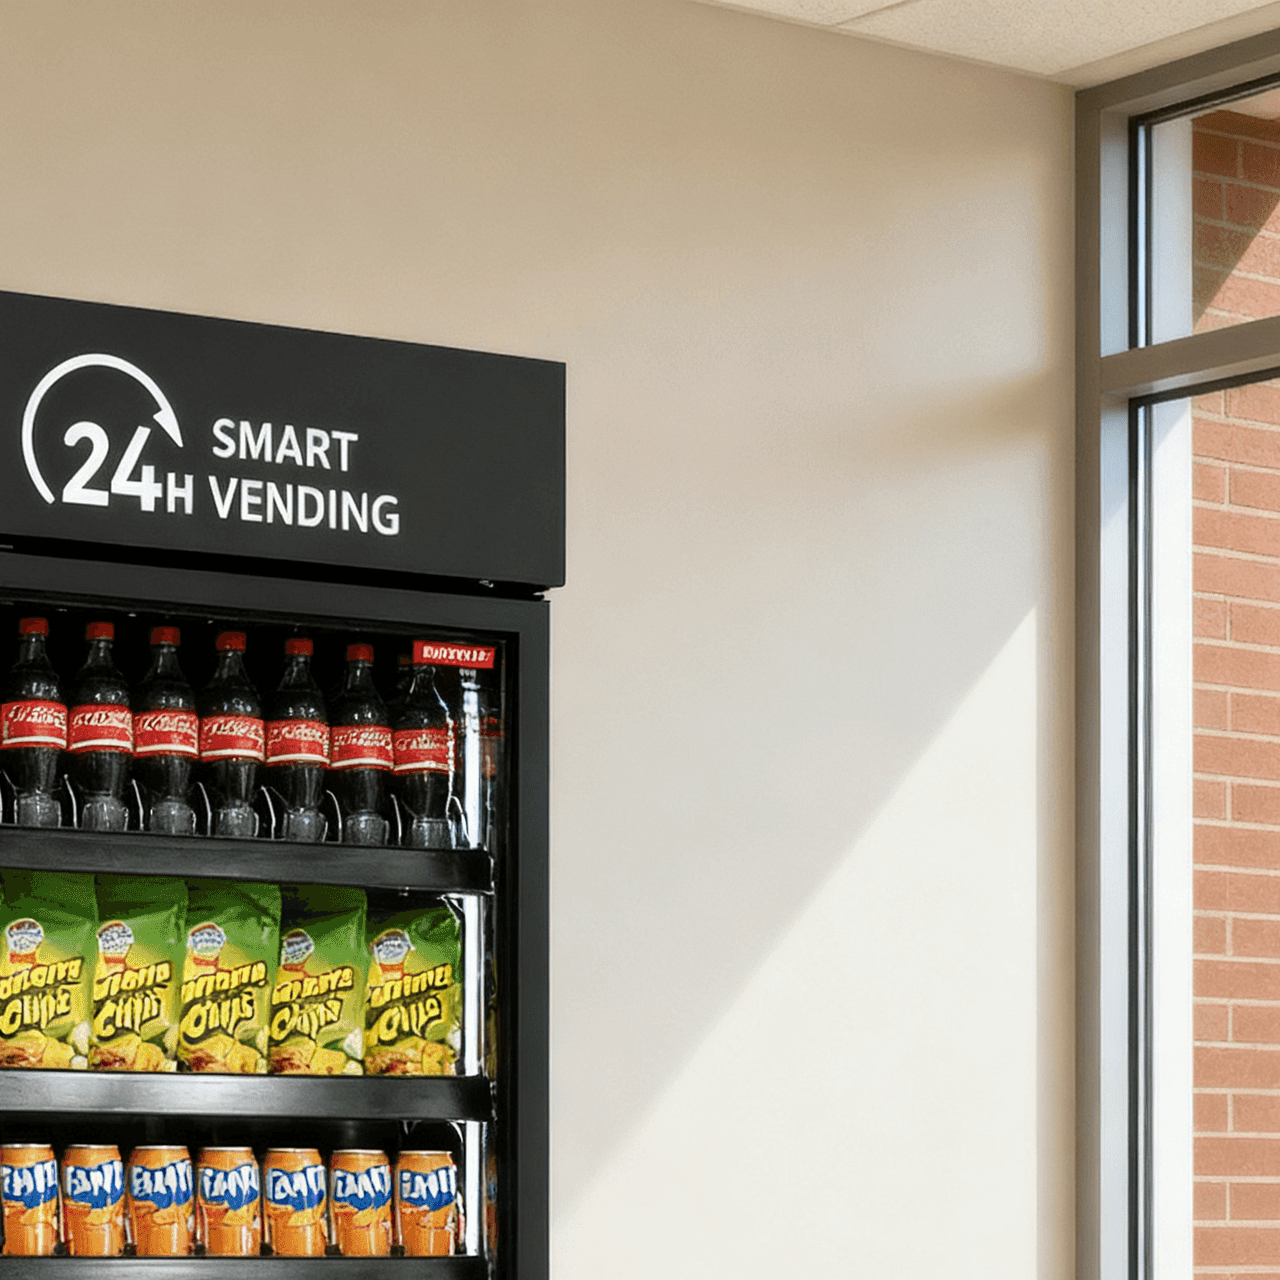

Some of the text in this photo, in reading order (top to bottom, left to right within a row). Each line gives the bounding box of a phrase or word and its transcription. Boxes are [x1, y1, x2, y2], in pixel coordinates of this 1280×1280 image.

[61, 421, 194, 515] 24H
[212, 417, 359, 472] SMART
[208, 475, 400, 536] VENDING
